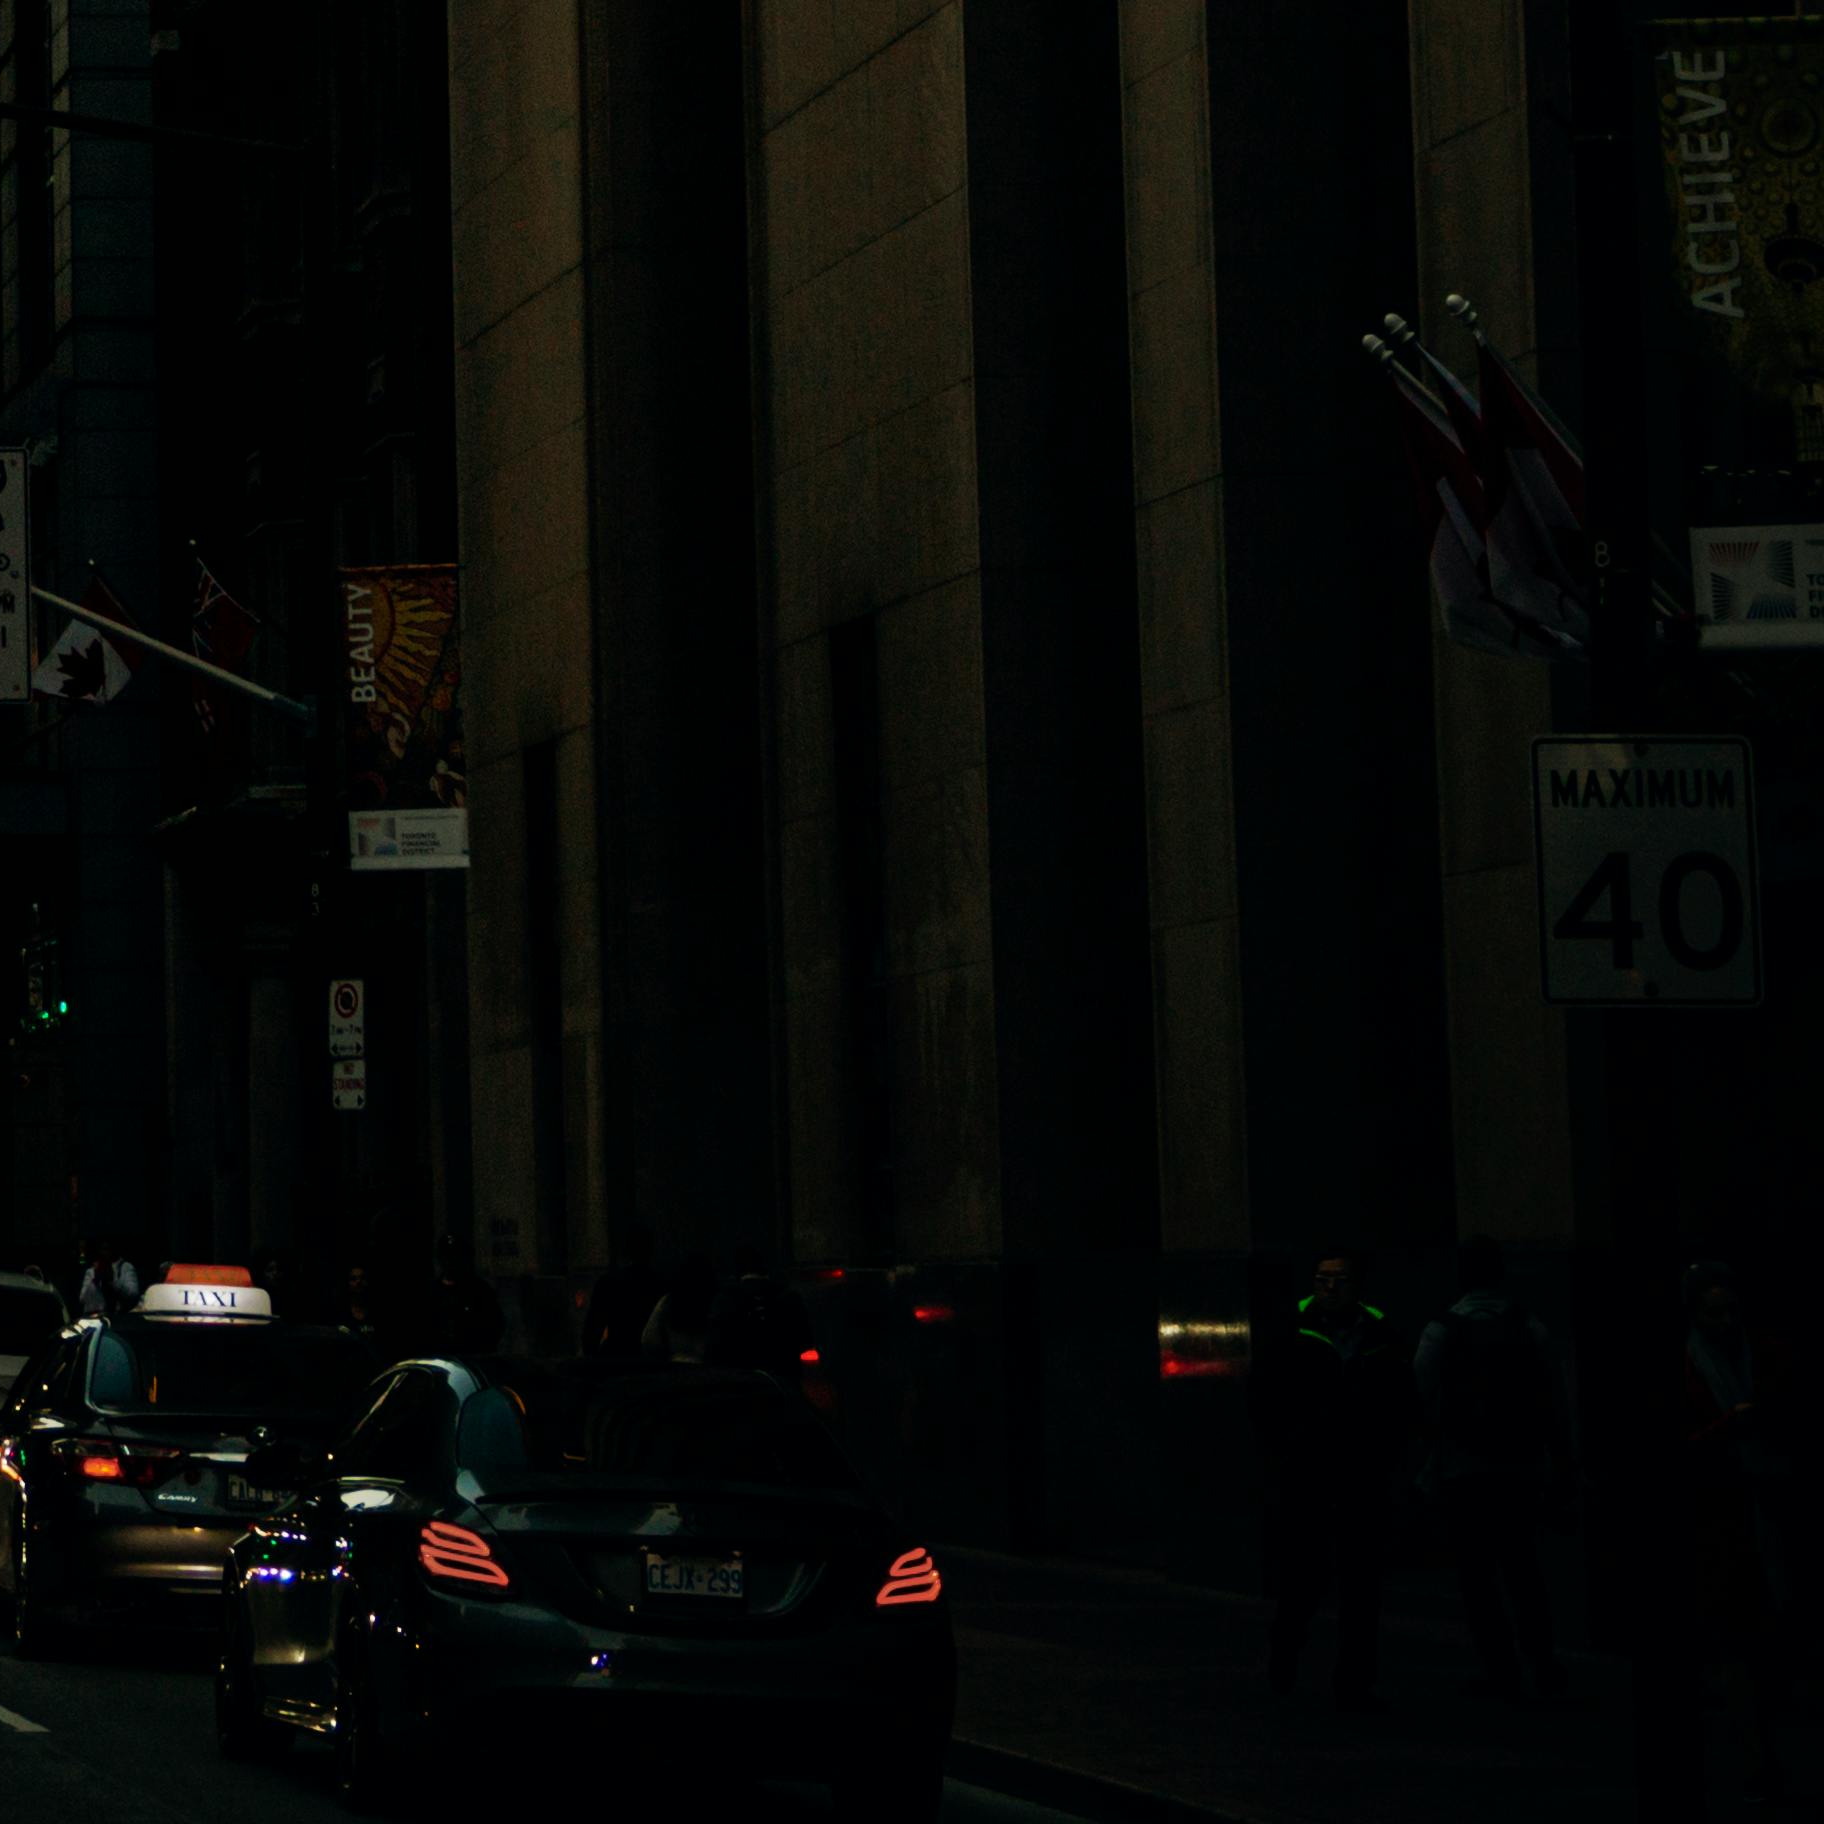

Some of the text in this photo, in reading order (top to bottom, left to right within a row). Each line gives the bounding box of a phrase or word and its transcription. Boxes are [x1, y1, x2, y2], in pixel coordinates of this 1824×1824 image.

[1672, 49, 1745, 318] ACHIEVE
[346, 582, 376, 704] BEAUTY
[1550, 768, 1735, 808] MAXIMUM
[1552, 850, 1744, 973] 40
